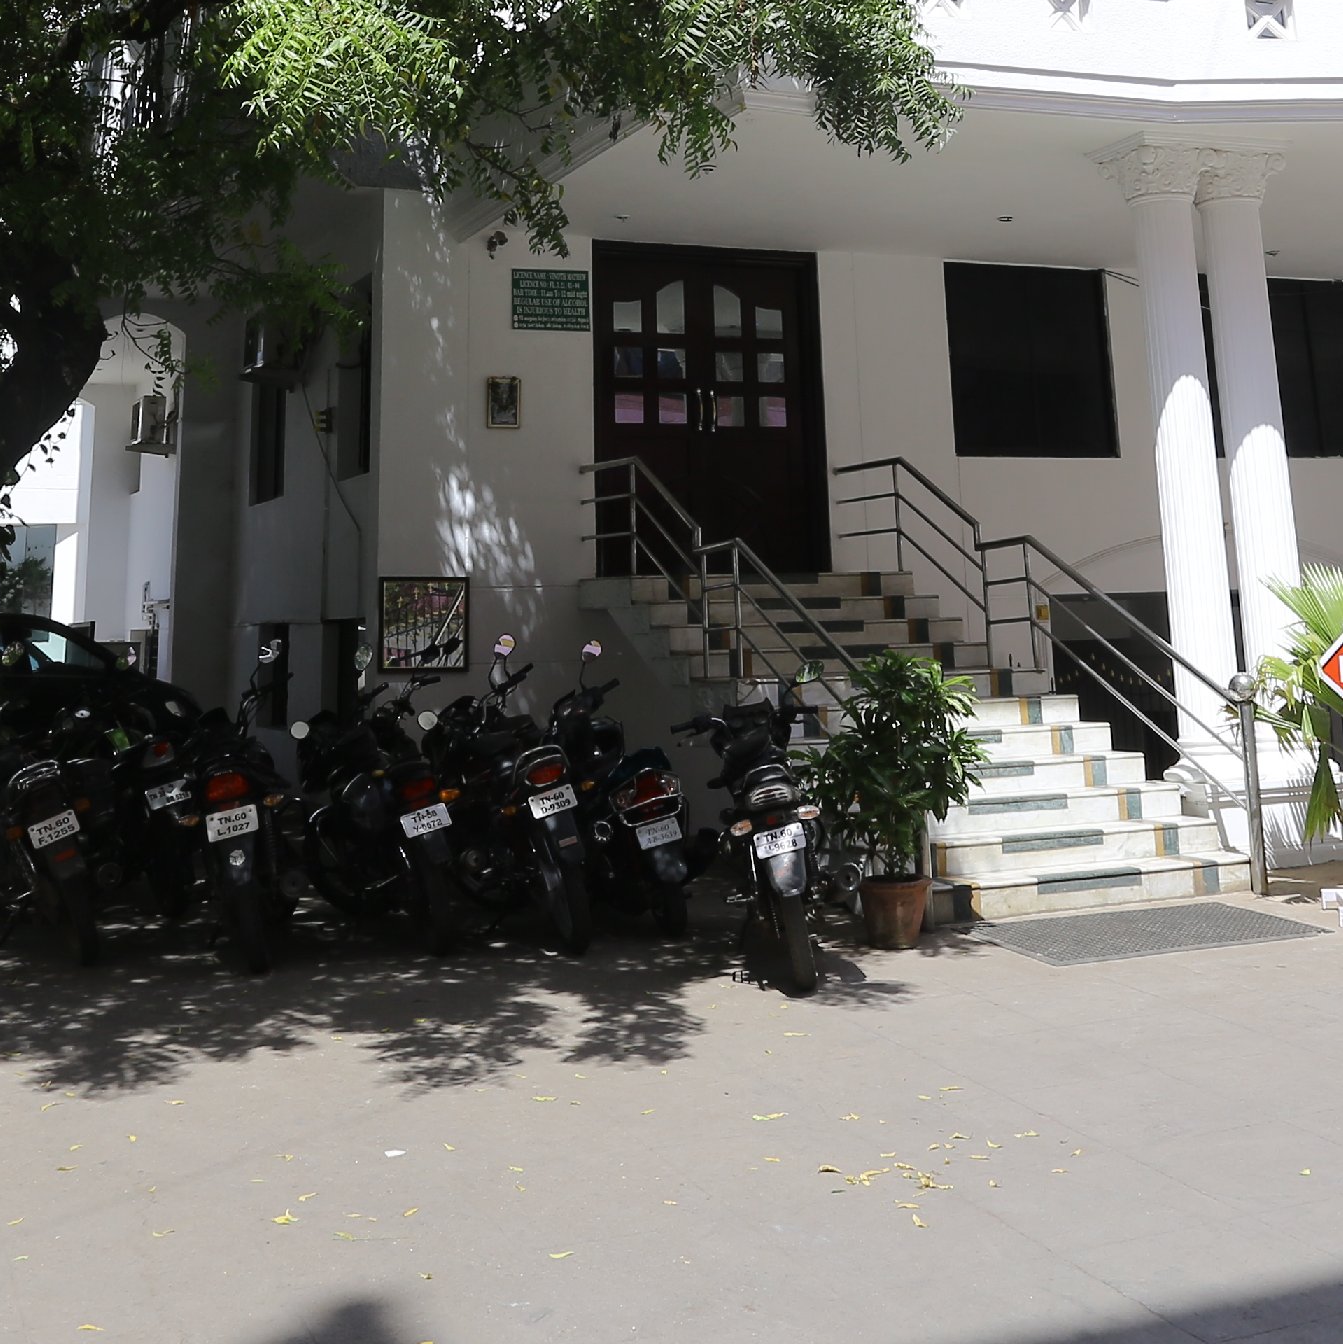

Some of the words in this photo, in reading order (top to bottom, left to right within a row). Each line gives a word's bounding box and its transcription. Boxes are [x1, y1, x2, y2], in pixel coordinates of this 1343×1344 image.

[36, 817, 70, 836] TN.60
[218, 812, 247, 825] TN.60
[38, 824, 75, 846] F.1255
[217, 822, 250, 837] L.1027
